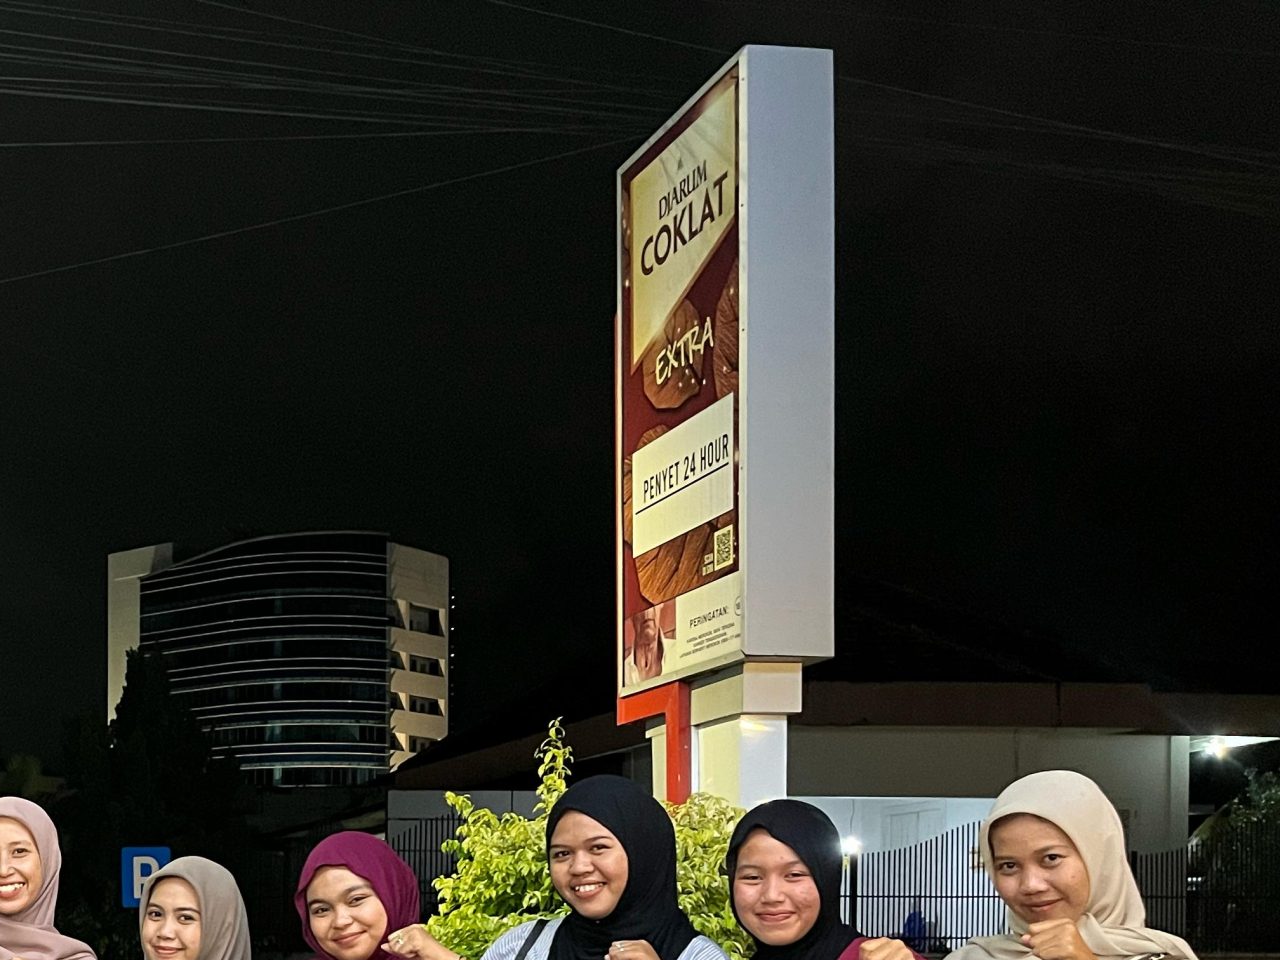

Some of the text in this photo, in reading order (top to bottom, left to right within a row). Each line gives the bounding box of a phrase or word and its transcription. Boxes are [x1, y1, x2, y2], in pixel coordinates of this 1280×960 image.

[640, 169, 729, 276] COKLAT
[655, 316, 714, 385] EXTRA
[643, 433, 729, 503] PENYET 24 HOUR
[133, 855, 160, 899] P
